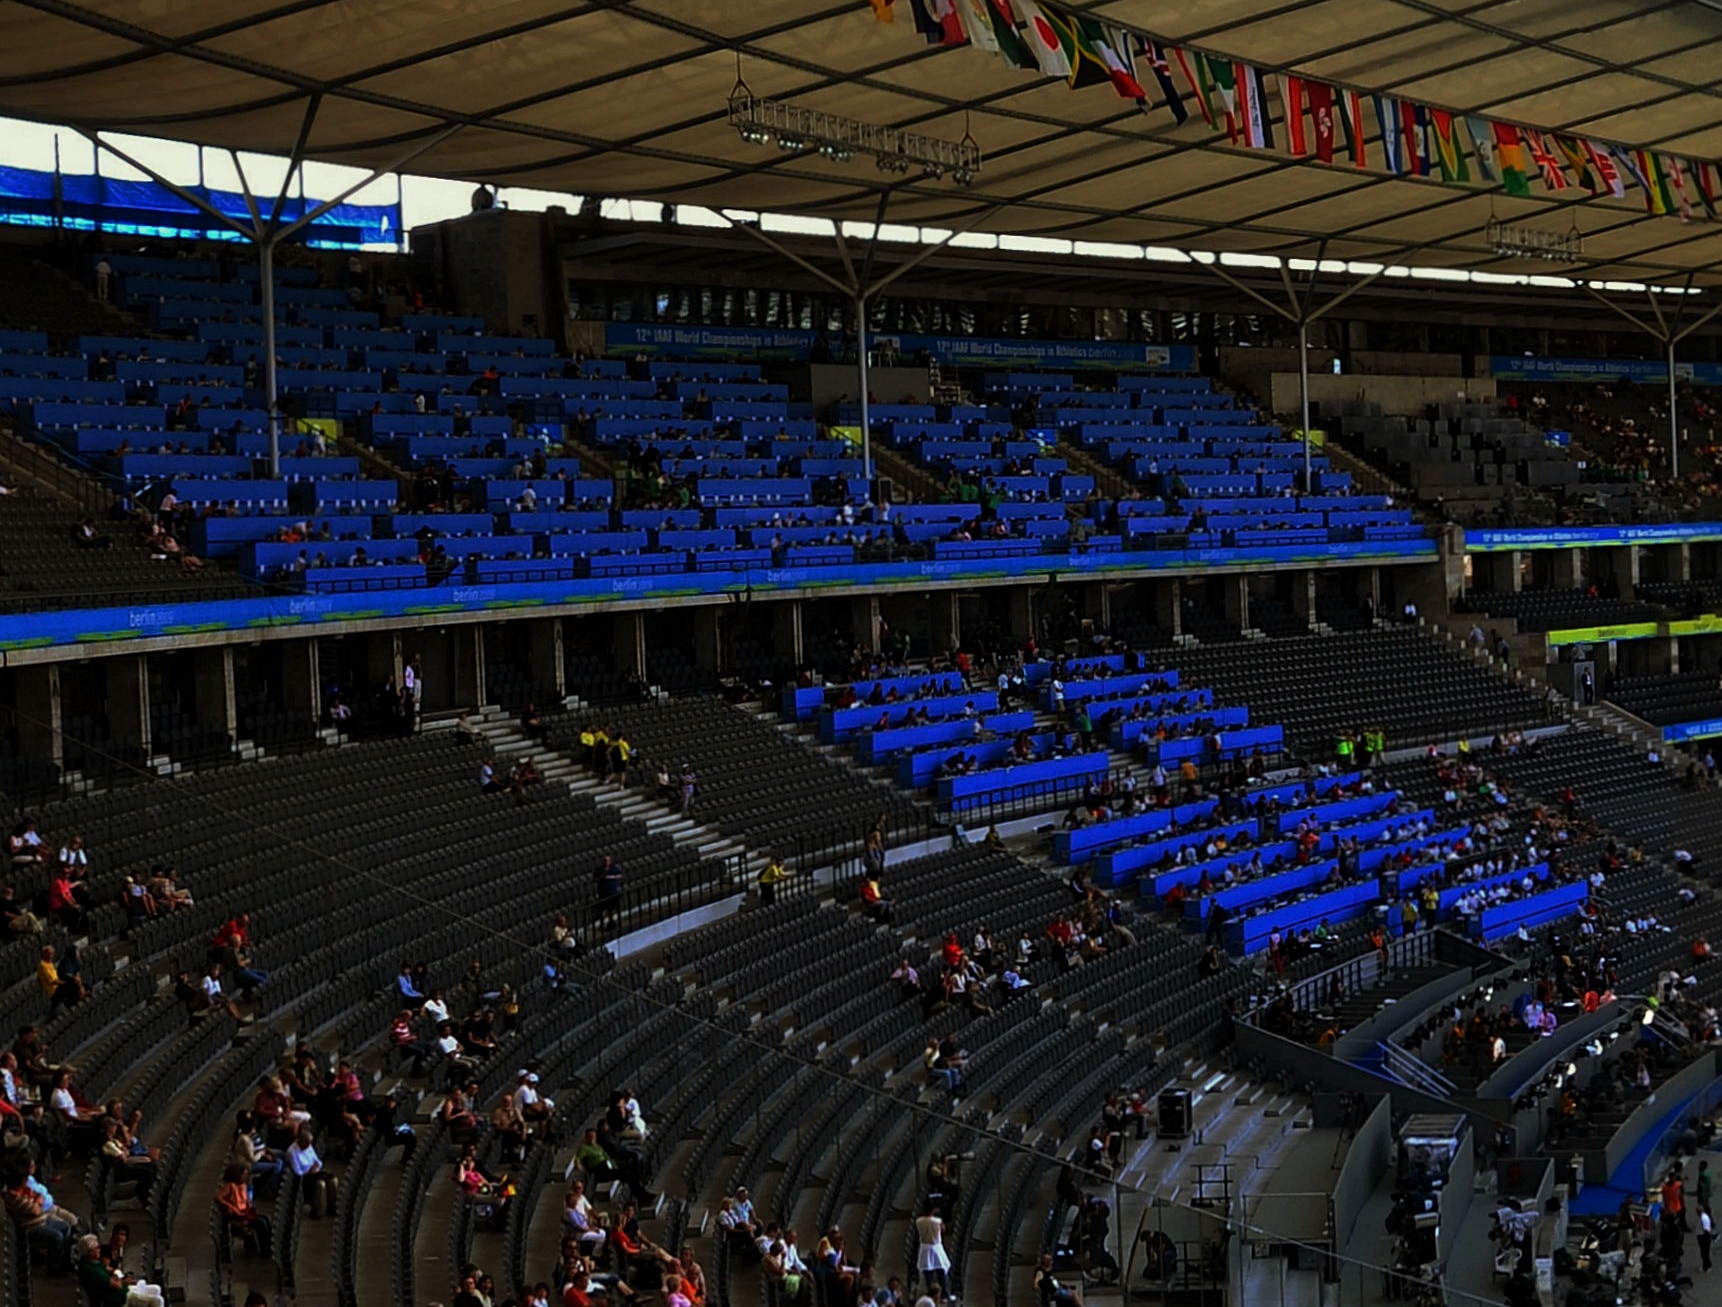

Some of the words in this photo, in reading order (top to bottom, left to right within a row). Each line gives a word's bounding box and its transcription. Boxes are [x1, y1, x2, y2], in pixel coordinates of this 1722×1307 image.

[654, 328, 672, 344] IAAF
[674, 329, 700, 345] World
[702, 330, 762, 349] Championships
[129, 610, 150, 628] berlin
